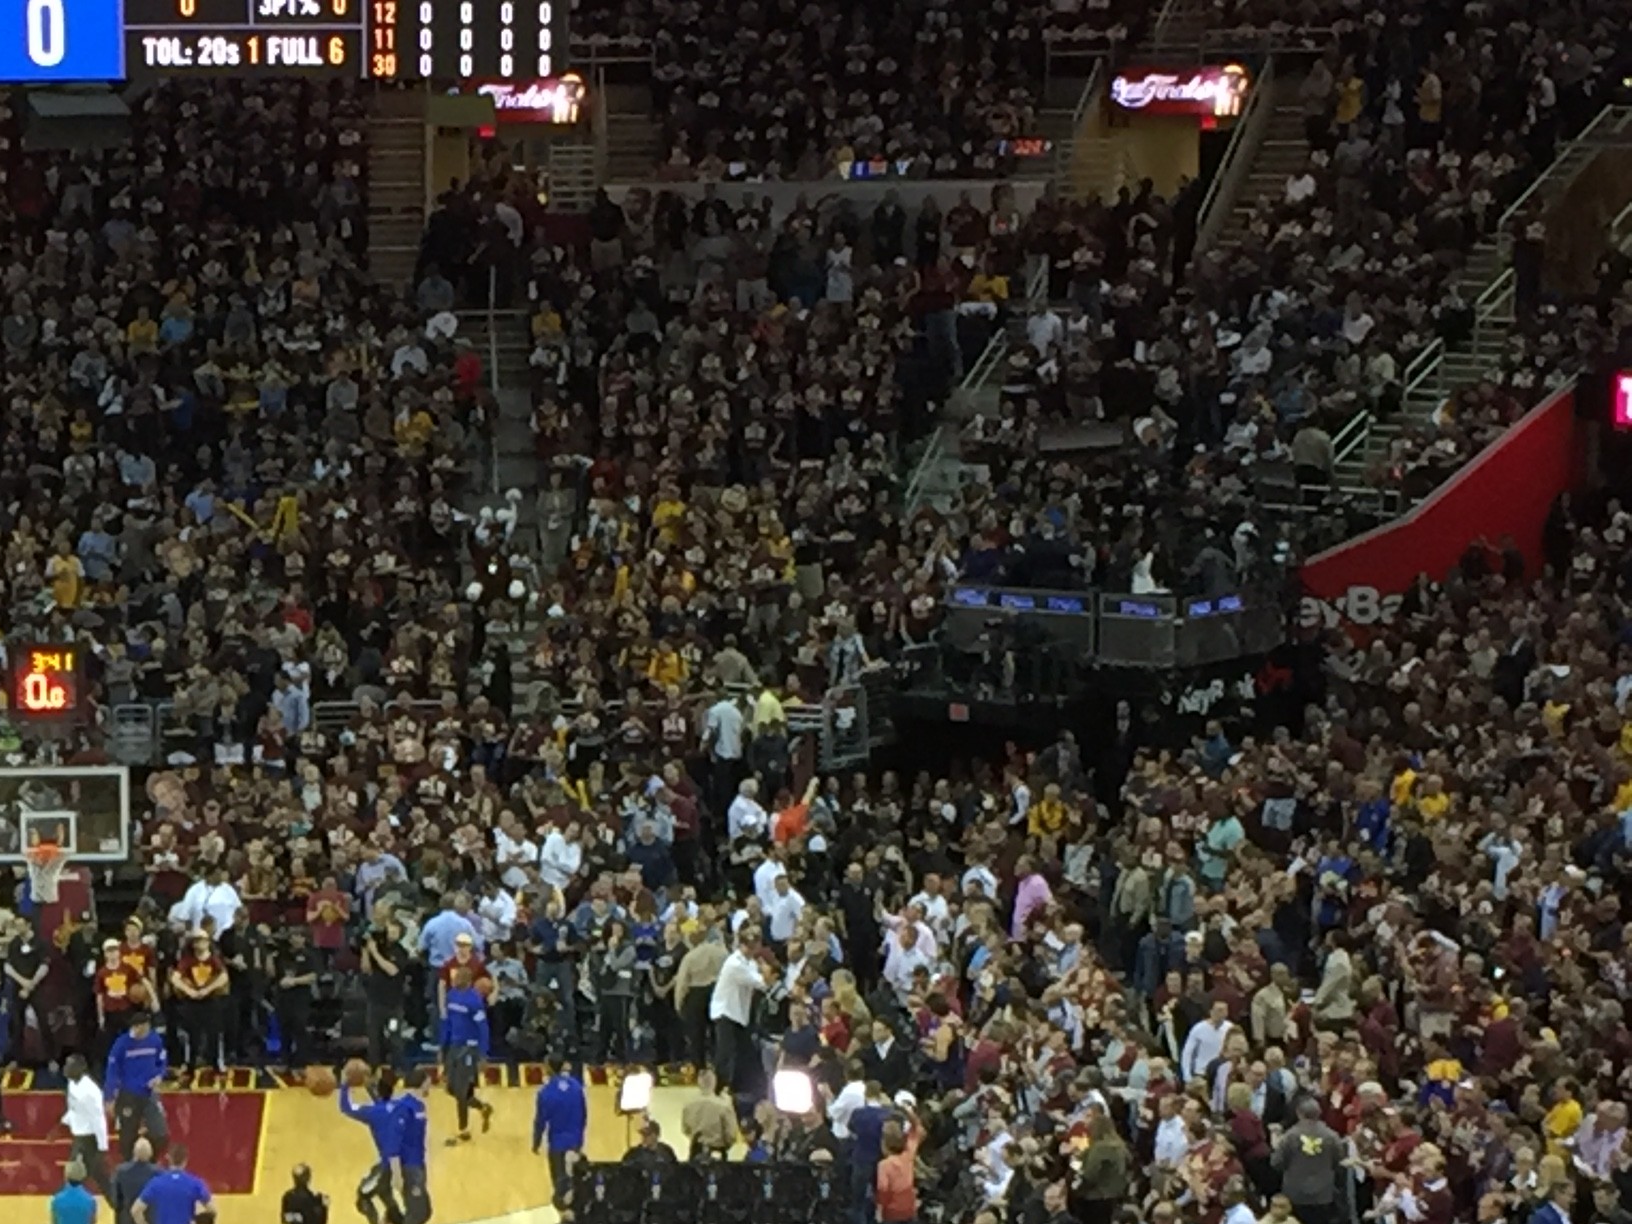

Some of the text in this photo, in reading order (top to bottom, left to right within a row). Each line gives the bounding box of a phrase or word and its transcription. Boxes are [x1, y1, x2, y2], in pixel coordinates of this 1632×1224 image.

[375, 2, 395, 24] 12
[27, 0, 64, 65] 0
[374, 28, 394, 50] 11
[142, 36, 344, 66] TOL: 20s 1 FULL 6
[373, 54, 396, 76] 30
